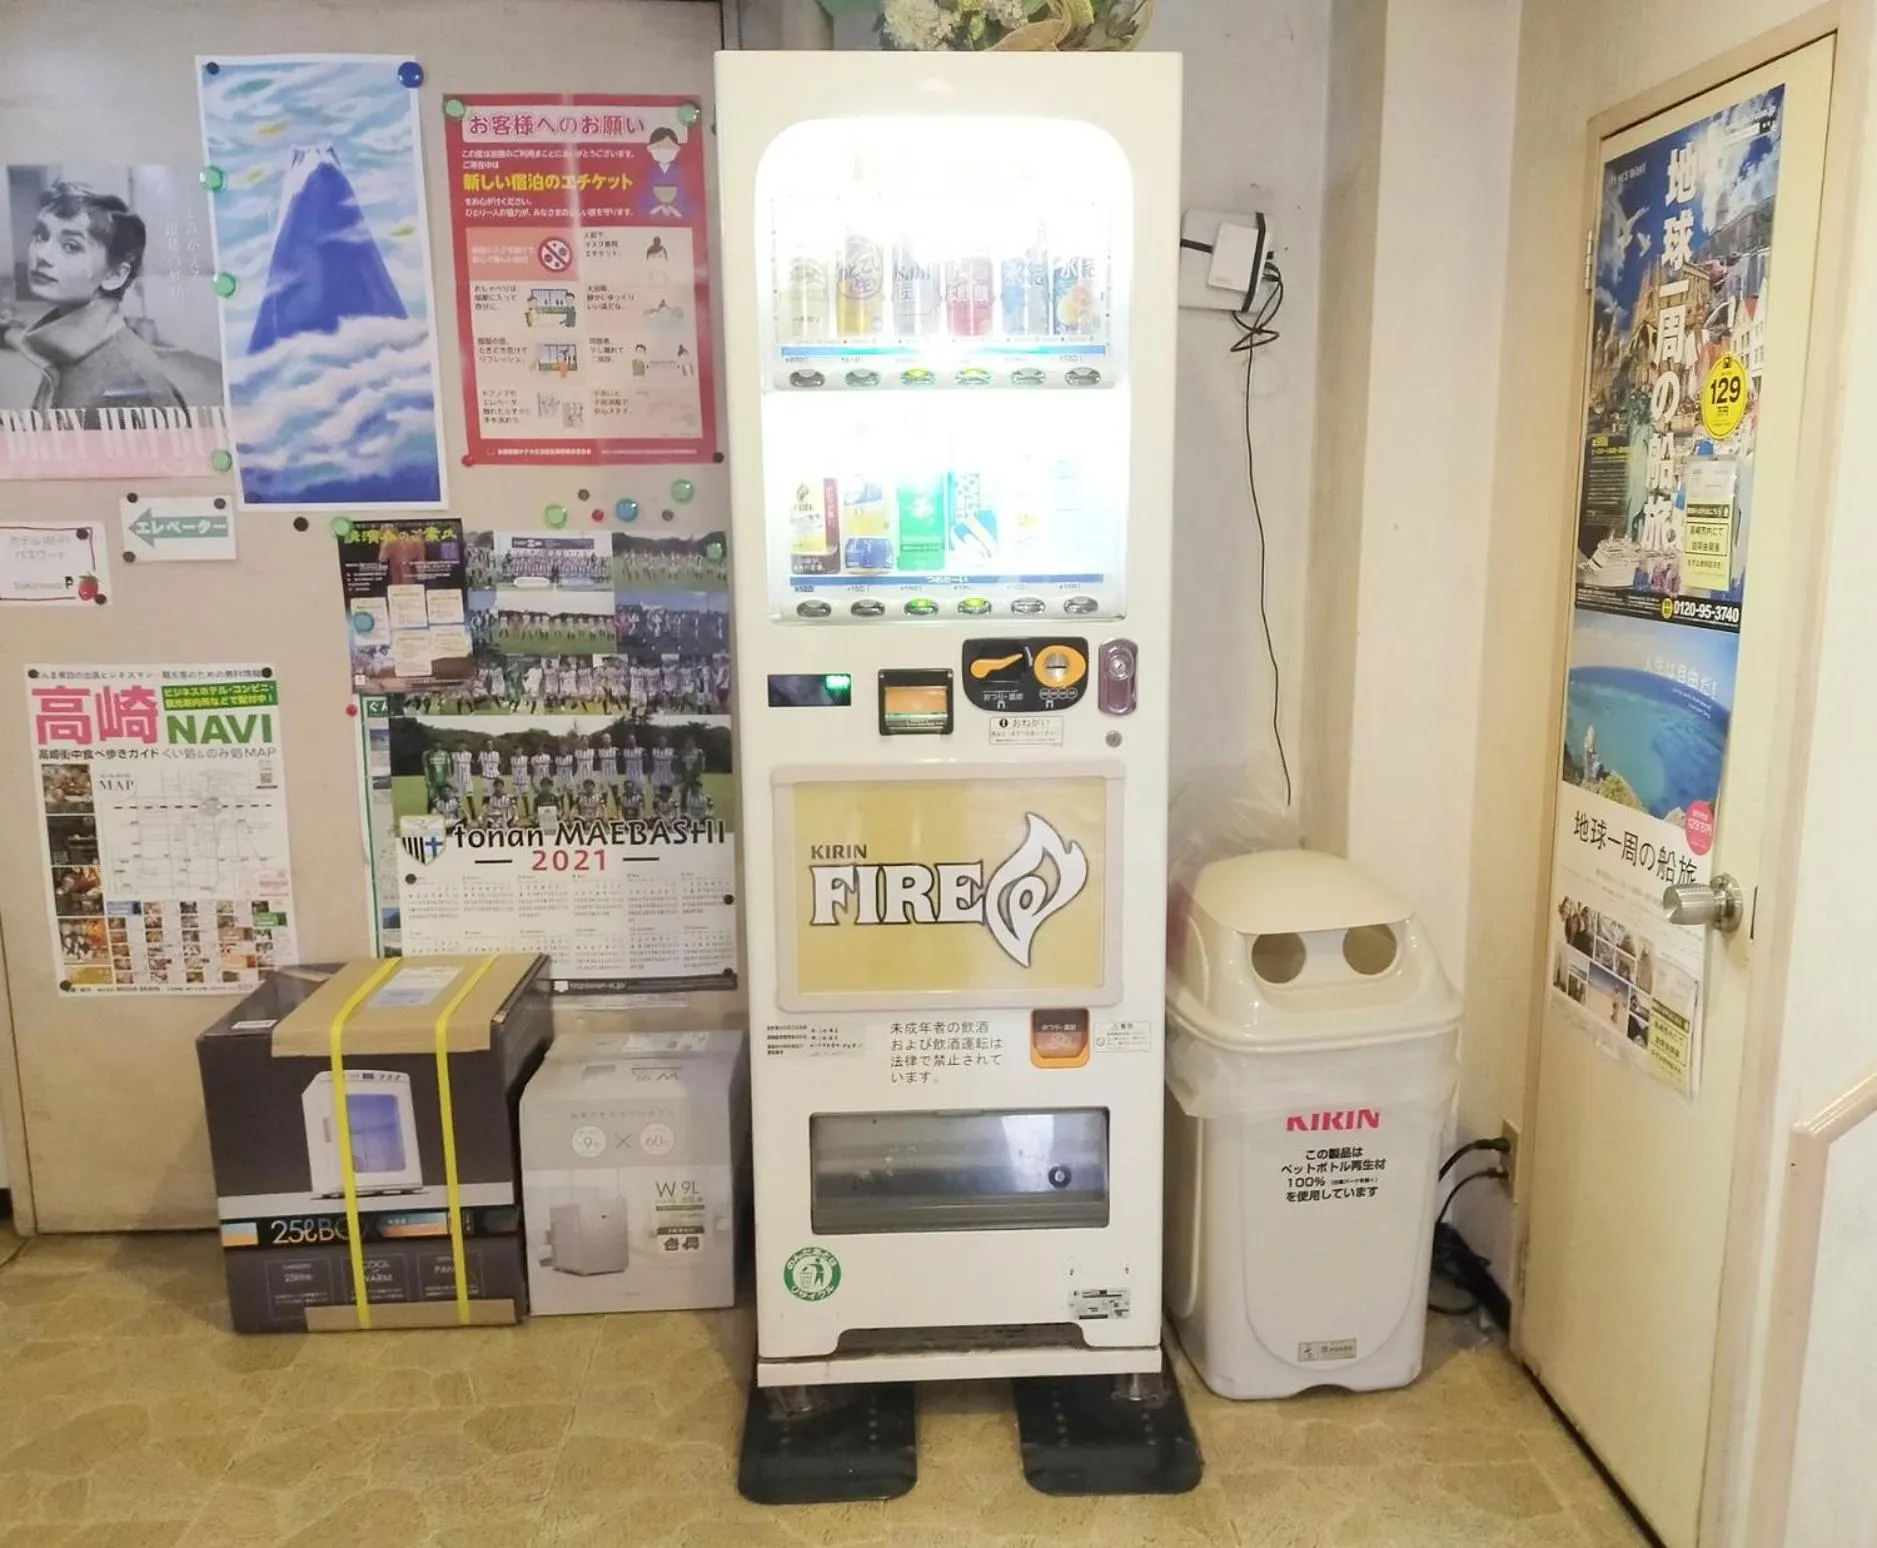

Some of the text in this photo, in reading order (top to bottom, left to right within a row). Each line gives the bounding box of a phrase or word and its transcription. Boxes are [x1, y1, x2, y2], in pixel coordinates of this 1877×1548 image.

[469, 115, 645, 135] お客様へのお願い
[463, 172, 634, 193] 新しい宿泊のエチケット
[1710, 376, 1741, 404] 129
[133, 520, 228, 535] エレベーター
[1673, 599, 1740, 624] 0120-95-3740
[31, 685, 159, 745] 高崎
[167, 714, 273, 745] NAVI
[99, 779, 134, 791] MAP
[453, 817, 727, 848] tonan MAEBASHI
[810, 845, 868, 859] KIRIN
[1573, 810, 1698, 885] 地球一周の船旅
[531, 850, 607, 872] 2021
[809, 860, 985, 926] FIRE
[890, 1020, 990, 1035] 未成年者の飲酒
[890, 1036, 1003, 1052] および飲酒運転は
[890, 1054, 1001, 1068] 法律で禁止されて
[890, 1070, 941, 1084] います。
[1305, 1148, 1363, 1161] この製品は
[1281, 1159, 1386, 1175] ペットボトル再生材
[1287, 1176, 1326, 1188] 100%
[1286, 1186, 1379, 1202] を使用しています
